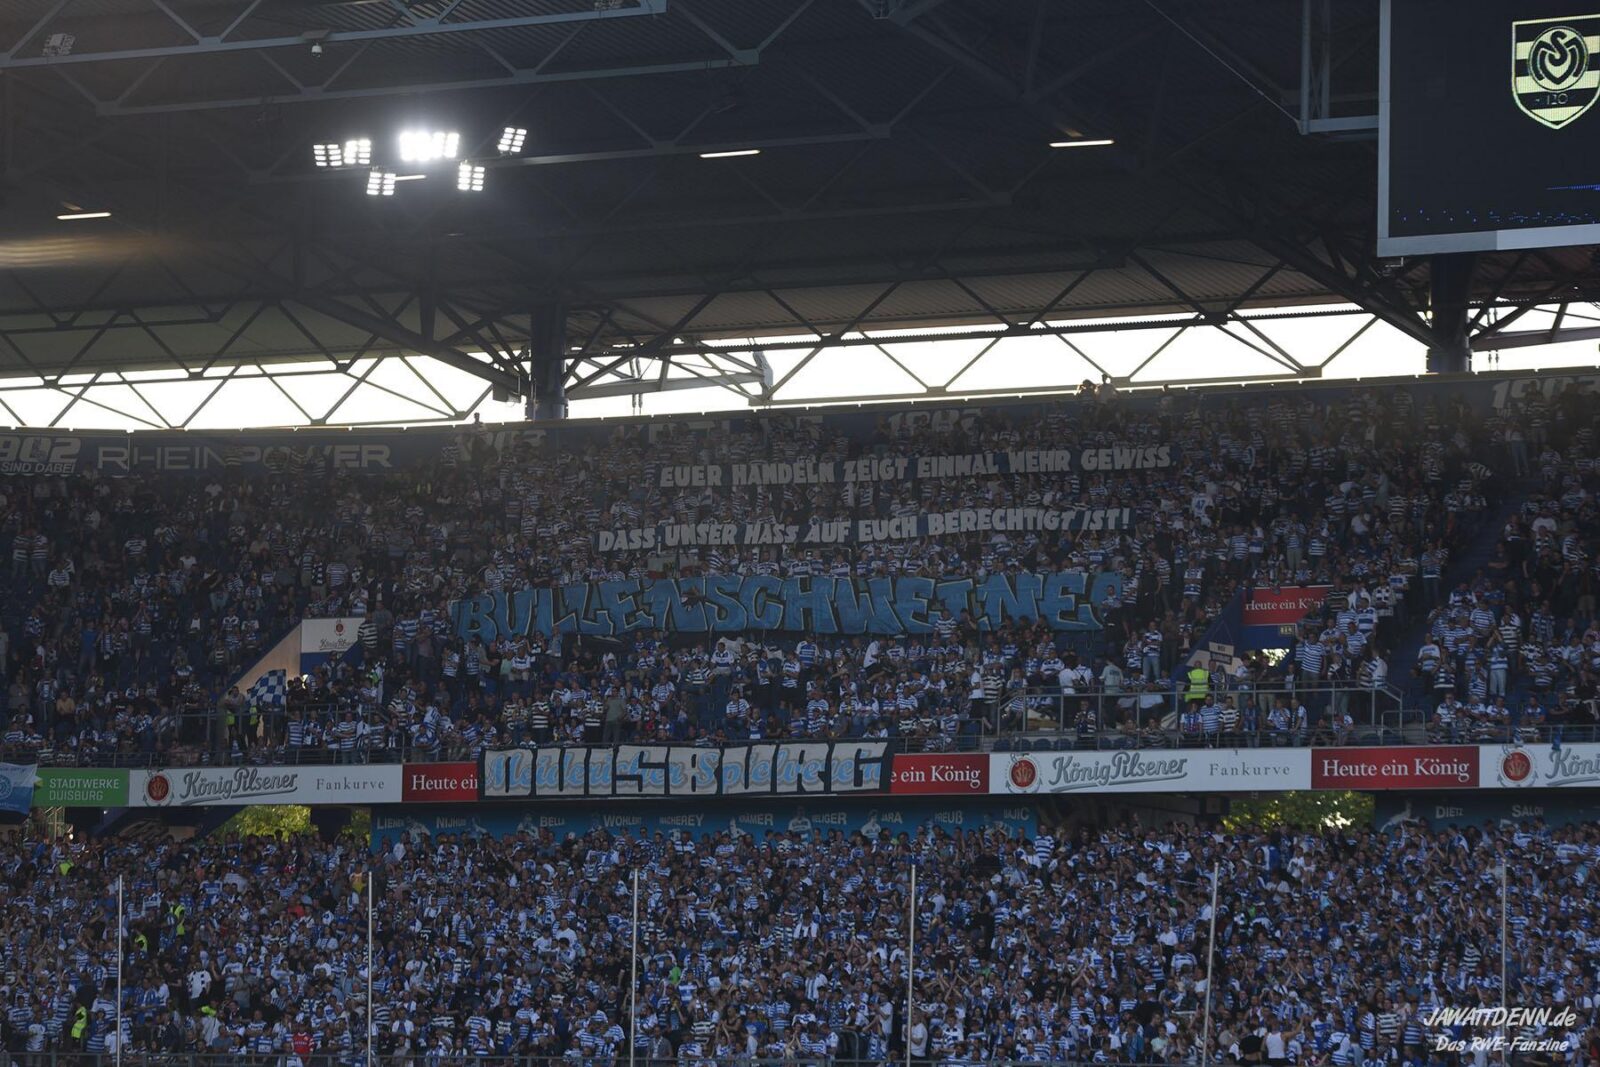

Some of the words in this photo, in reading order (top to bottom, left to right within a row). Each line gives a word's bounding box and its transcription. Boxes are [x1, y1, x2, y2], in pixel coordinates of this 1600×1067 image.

[34, 463, 76, 474] DABEI
[660, 464, 723, 487] EUER
[843, 457, 908, 482] ZEIGT
[917, 453, 999, 478] EINMAL
[1007, 449, 1071, 473] MEHR
[599, 528, 656, 551] DASS
[665, 522, 738, 546] UNSER
[744, 522, 799, 544] HASS
[803, 520, 850, 543] AUF
[858, 515, 918, 542] EUCH
[928, 508, 1076, 536] BERECHTIGT
[1082, 507, 1130, 531] IST!
[1209, 762, 1290, 776] Fankurve
[1322, 759, 1377, 777] Heute
[1384, 759, 1408, 776] ein
[1414, 758, 1470, 782] König
[50, 778, 119, 789] STADTWERKE
[316, 777, 385, 790] Fankurve
[411, 774, 457, 791] Heute
[901, 766, 926, 783] ein
[930, 765, 981, 789] König
[50, 790, 103, 800] DUISBURG
